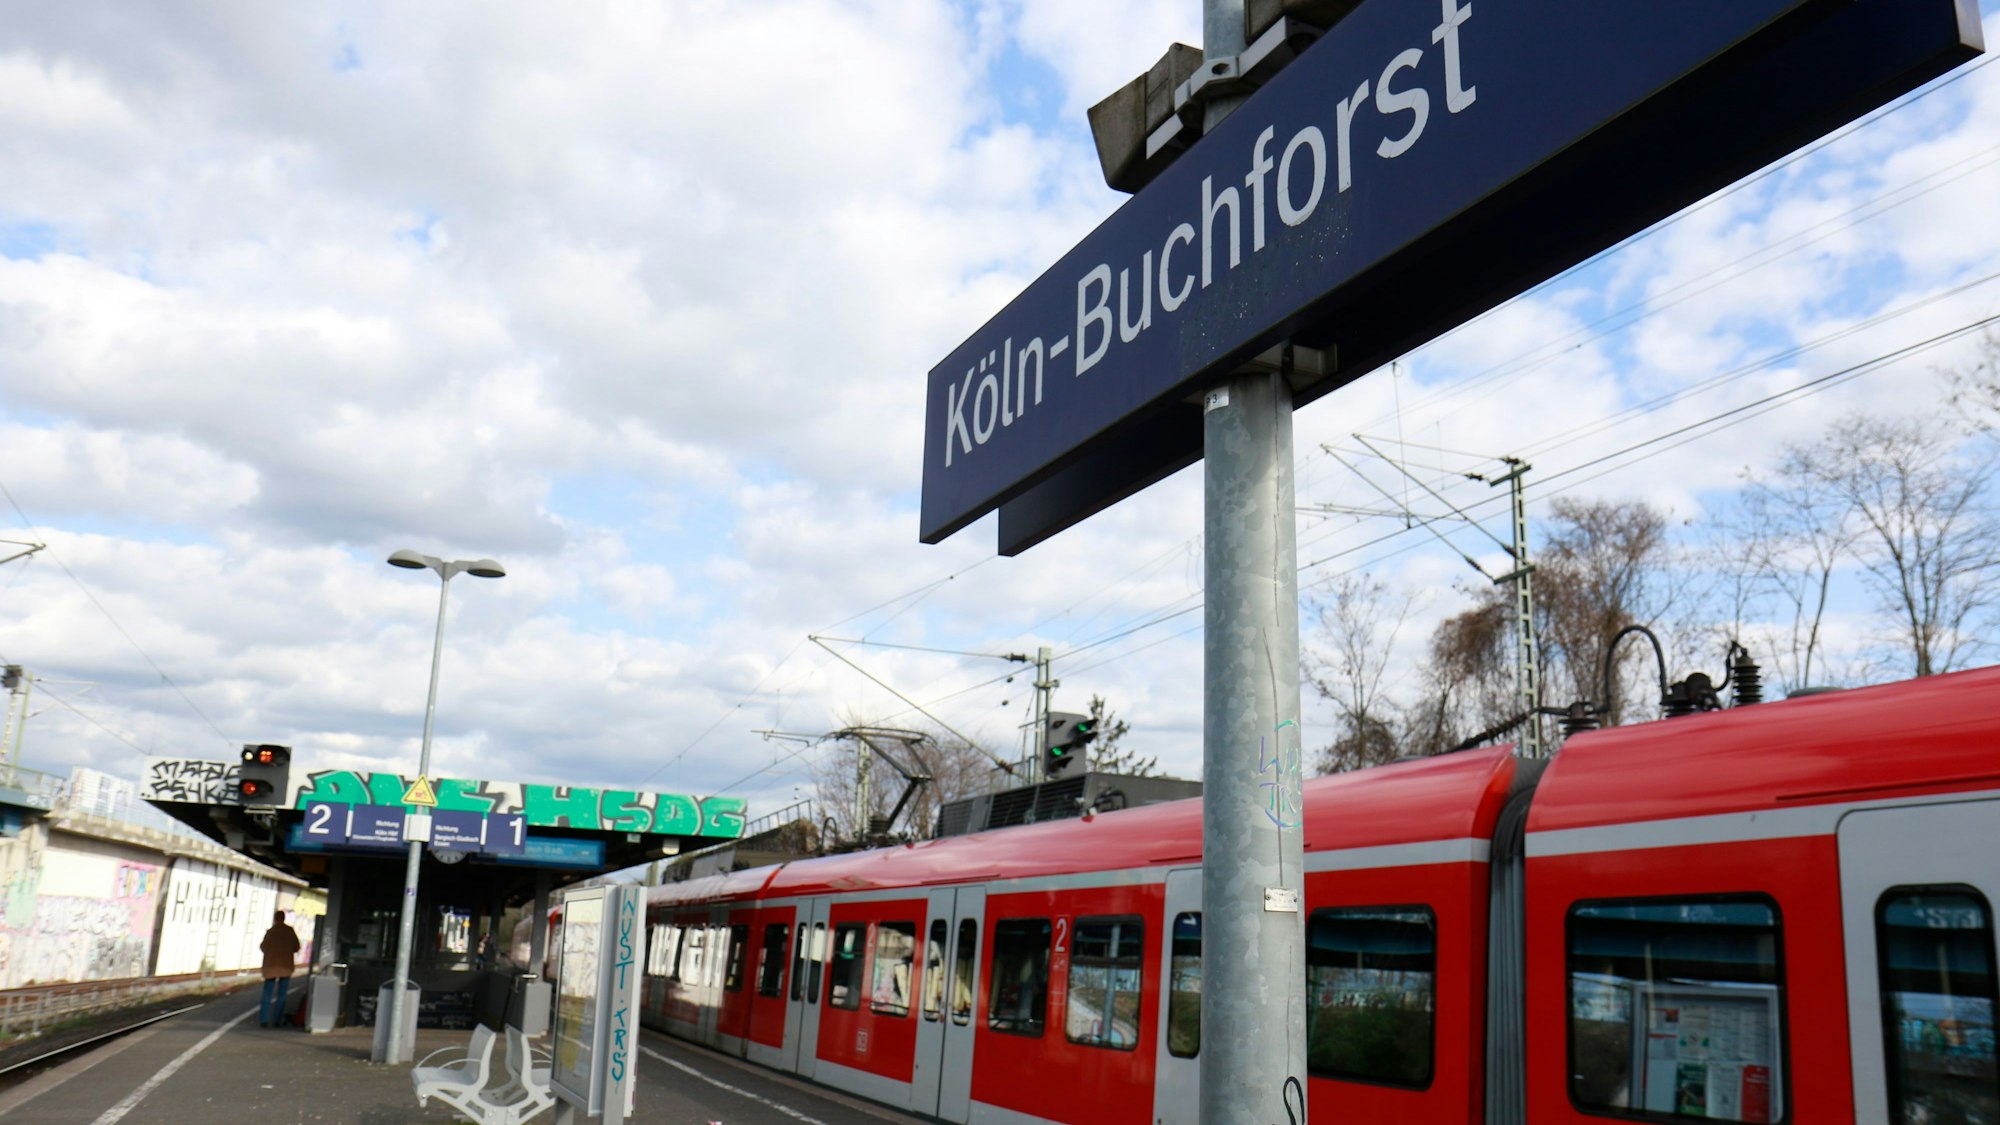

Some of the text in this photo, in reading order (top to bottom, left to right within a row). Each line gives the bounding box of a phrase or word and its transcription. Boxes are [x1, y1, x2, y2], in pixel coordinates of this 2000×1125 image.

[945, 0, 1477, 468] Köln-Buchforst
[308, 804, 332, 834] 2
[509, 817, 523, 846] 1
[1055, 918, 1067, 952] 2
